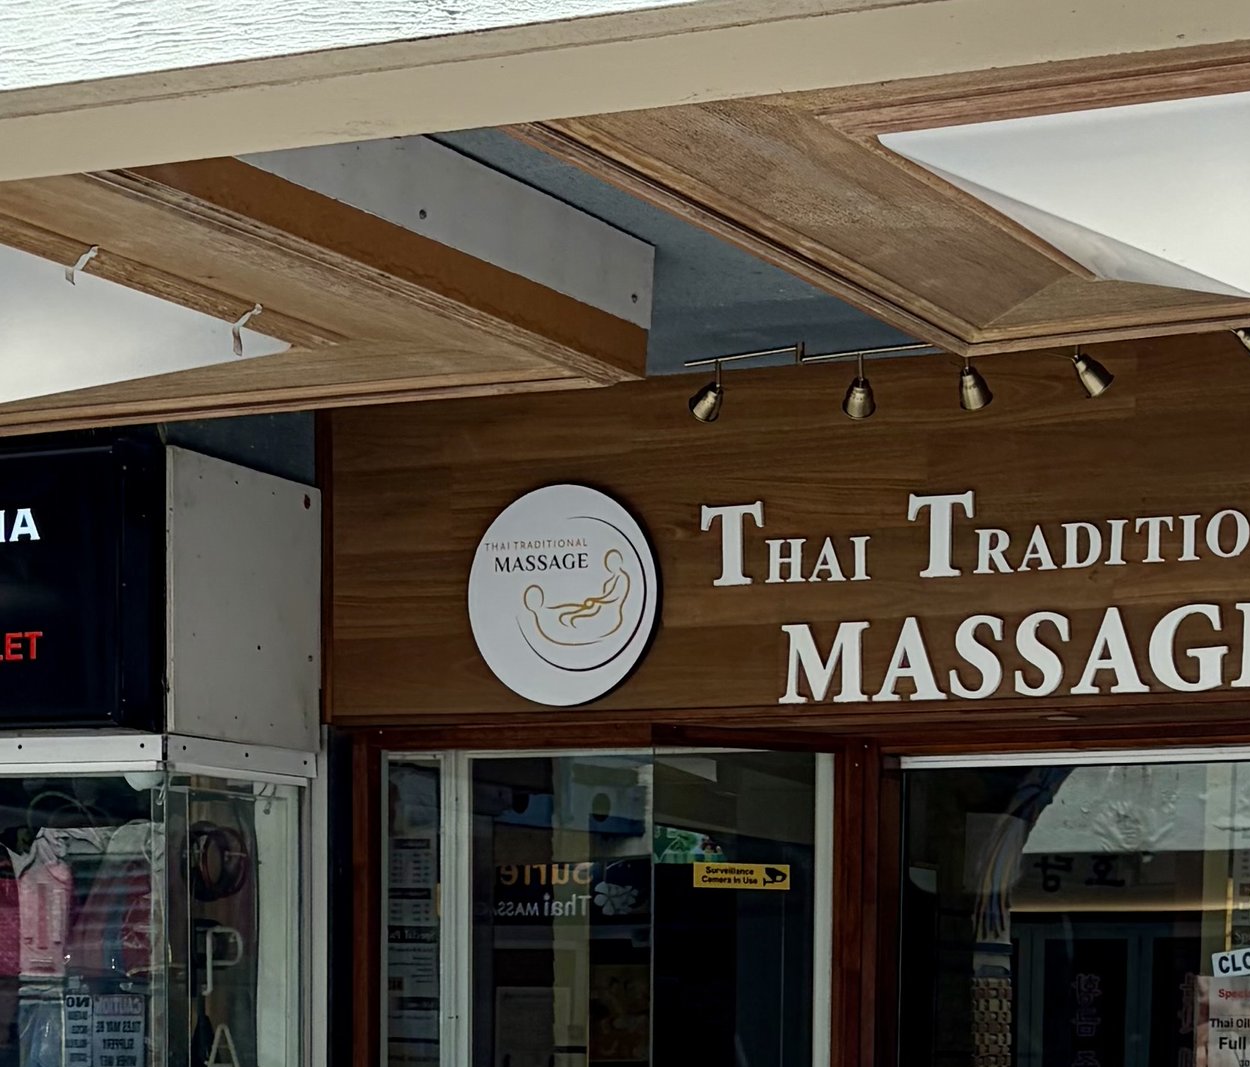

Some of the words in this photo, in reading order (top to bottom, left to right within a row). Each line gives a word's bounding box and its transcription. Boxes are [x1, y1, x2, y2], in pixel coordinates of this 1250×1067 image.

[485, 541, 511, 552] THAI
[513, 538, 588, 551] TRADITIONAL
[700, 500, 871, 587] THAI
[494, 553, 589, 572] MASSAGE
[0, 631, 43, 662] ET
[705, 866, 754, 876] Surveillance
[702, 875, 732, 884] Camera
[734, 876, 741, 884] In
[743, 877, 758, 885] Use
[1210, 1017, 1234, 1028] Thai
[1236, 1017, 1250, 1028] Oil
[1218, 1037, 1246, 1050] Full
